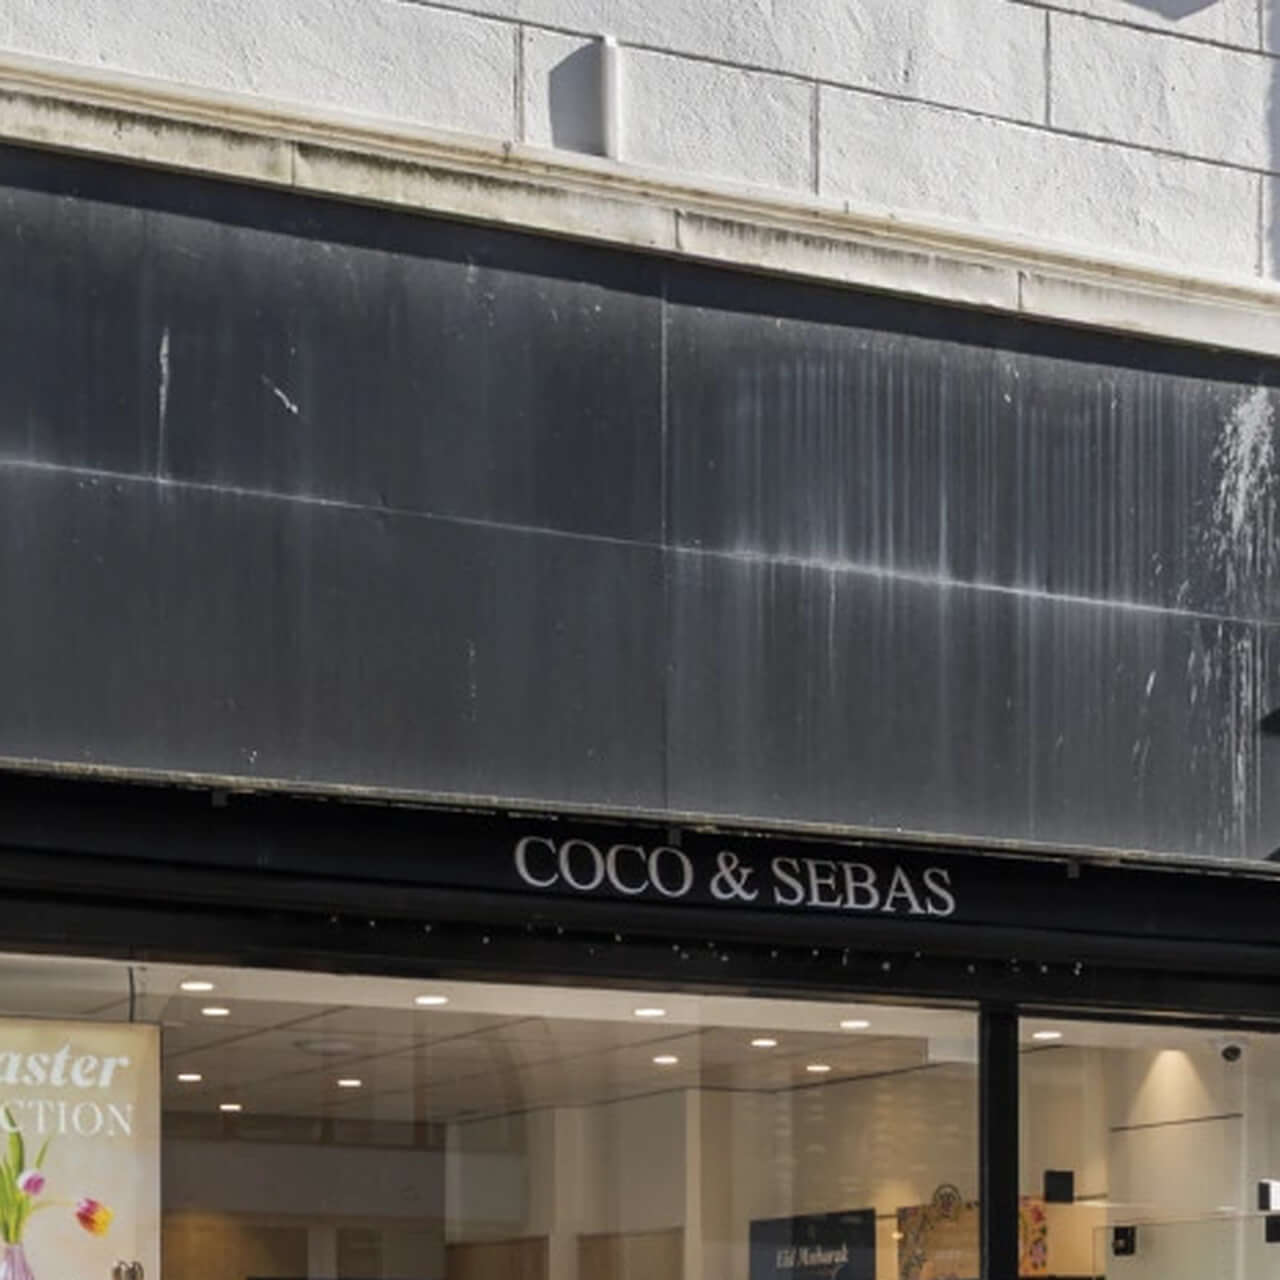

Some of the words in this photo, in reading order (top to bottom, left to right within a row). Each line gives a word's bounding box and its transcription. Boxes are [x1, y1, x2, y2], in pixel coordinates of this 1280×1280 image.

[514, 835, 694, 898] COCO
[709, 851, 758, 901] &
[771, 856, 956, 917] SEBAS
